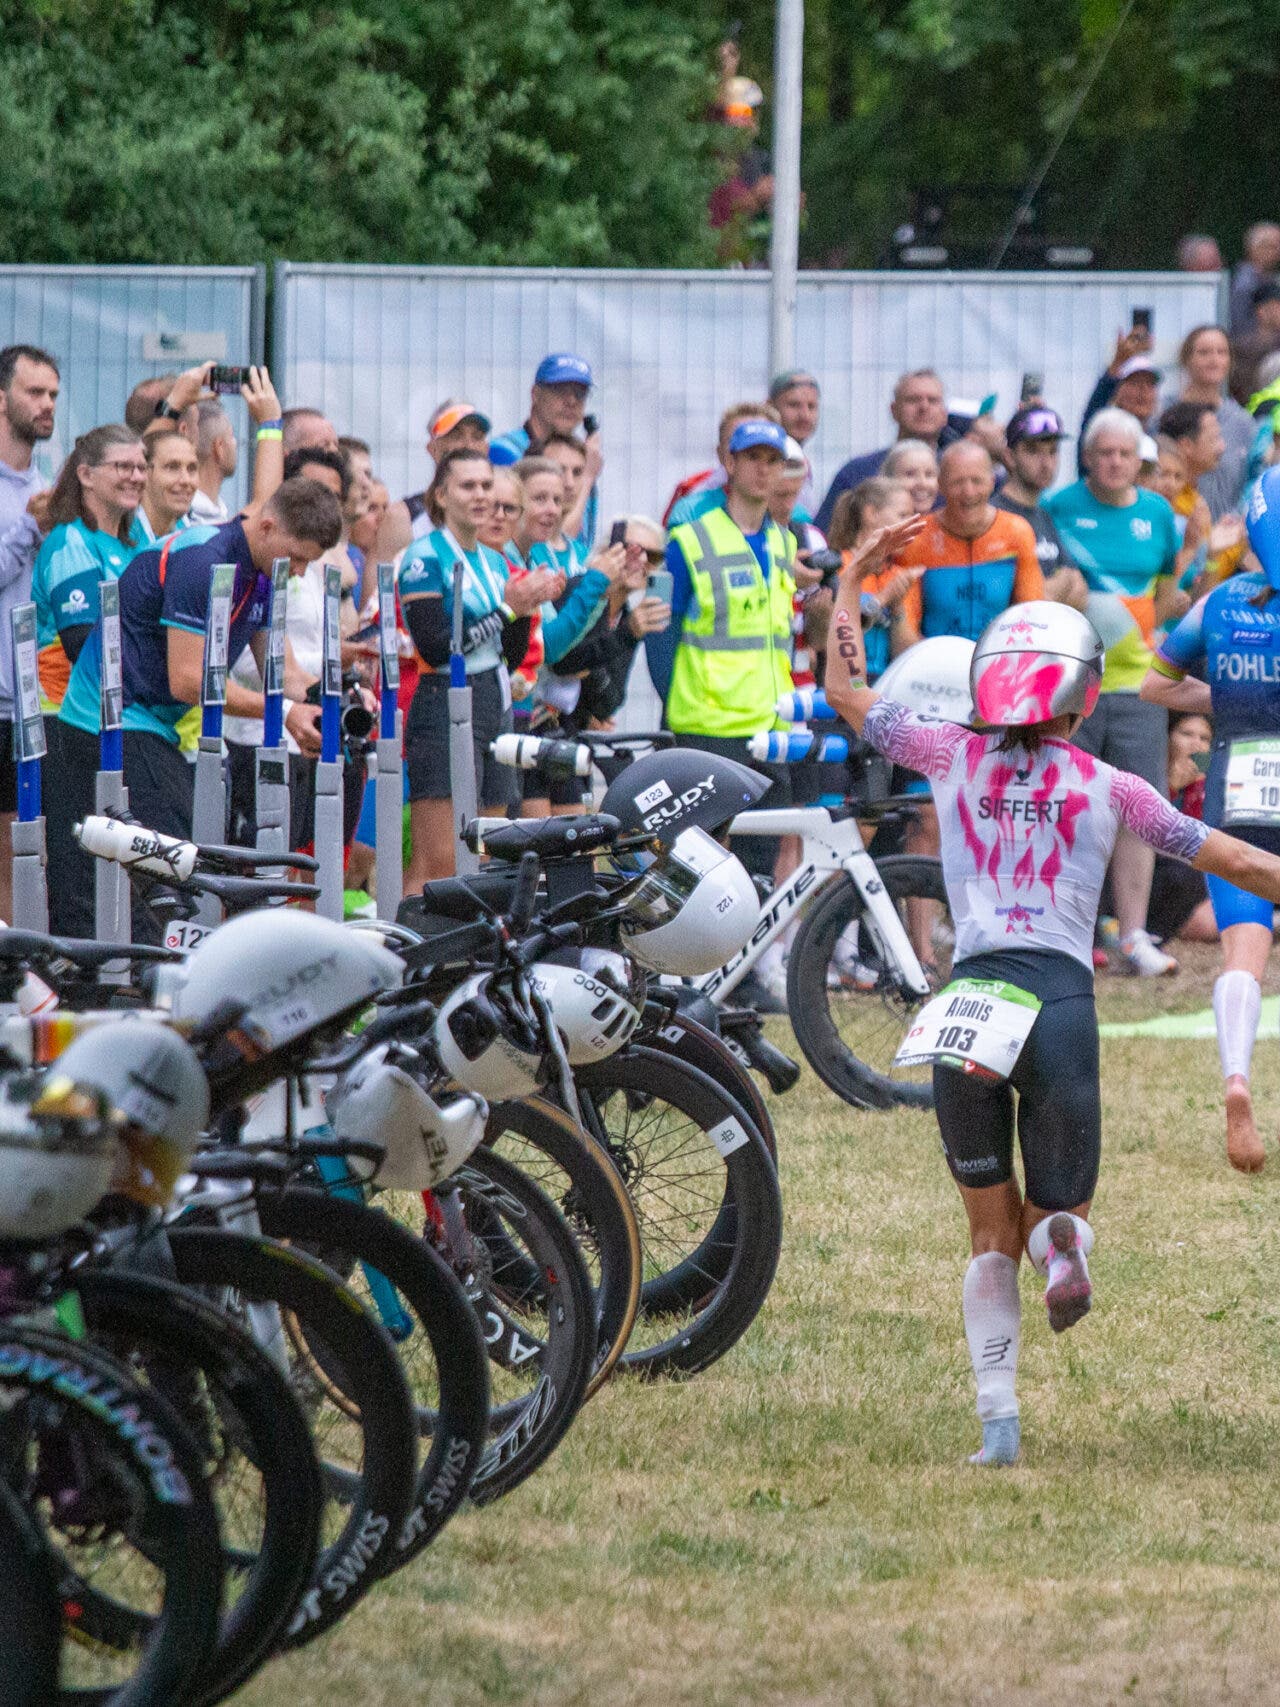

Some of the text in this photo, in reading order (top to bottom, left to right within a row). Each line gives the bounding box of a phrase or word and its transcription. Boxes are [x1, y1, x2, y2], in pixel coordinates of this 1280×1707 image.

[642, 774, 716, 830] RUDY
[643, 787, 664, 806] 123
[978, 796, 1068, 823] SIFFERT
[715, 895, 734, 913] 122
[177, 925, 213, 948] 12
[573, 973, 608, 998] poc
[945, 996, 994, 1023] Alanis
[590, 1035, 607, 1050] 121
[935, 1025, 978, 1053] 103
[425, 1436, 471, 1515] SWISS
[323, 1509, 390, 1601] SWISS
